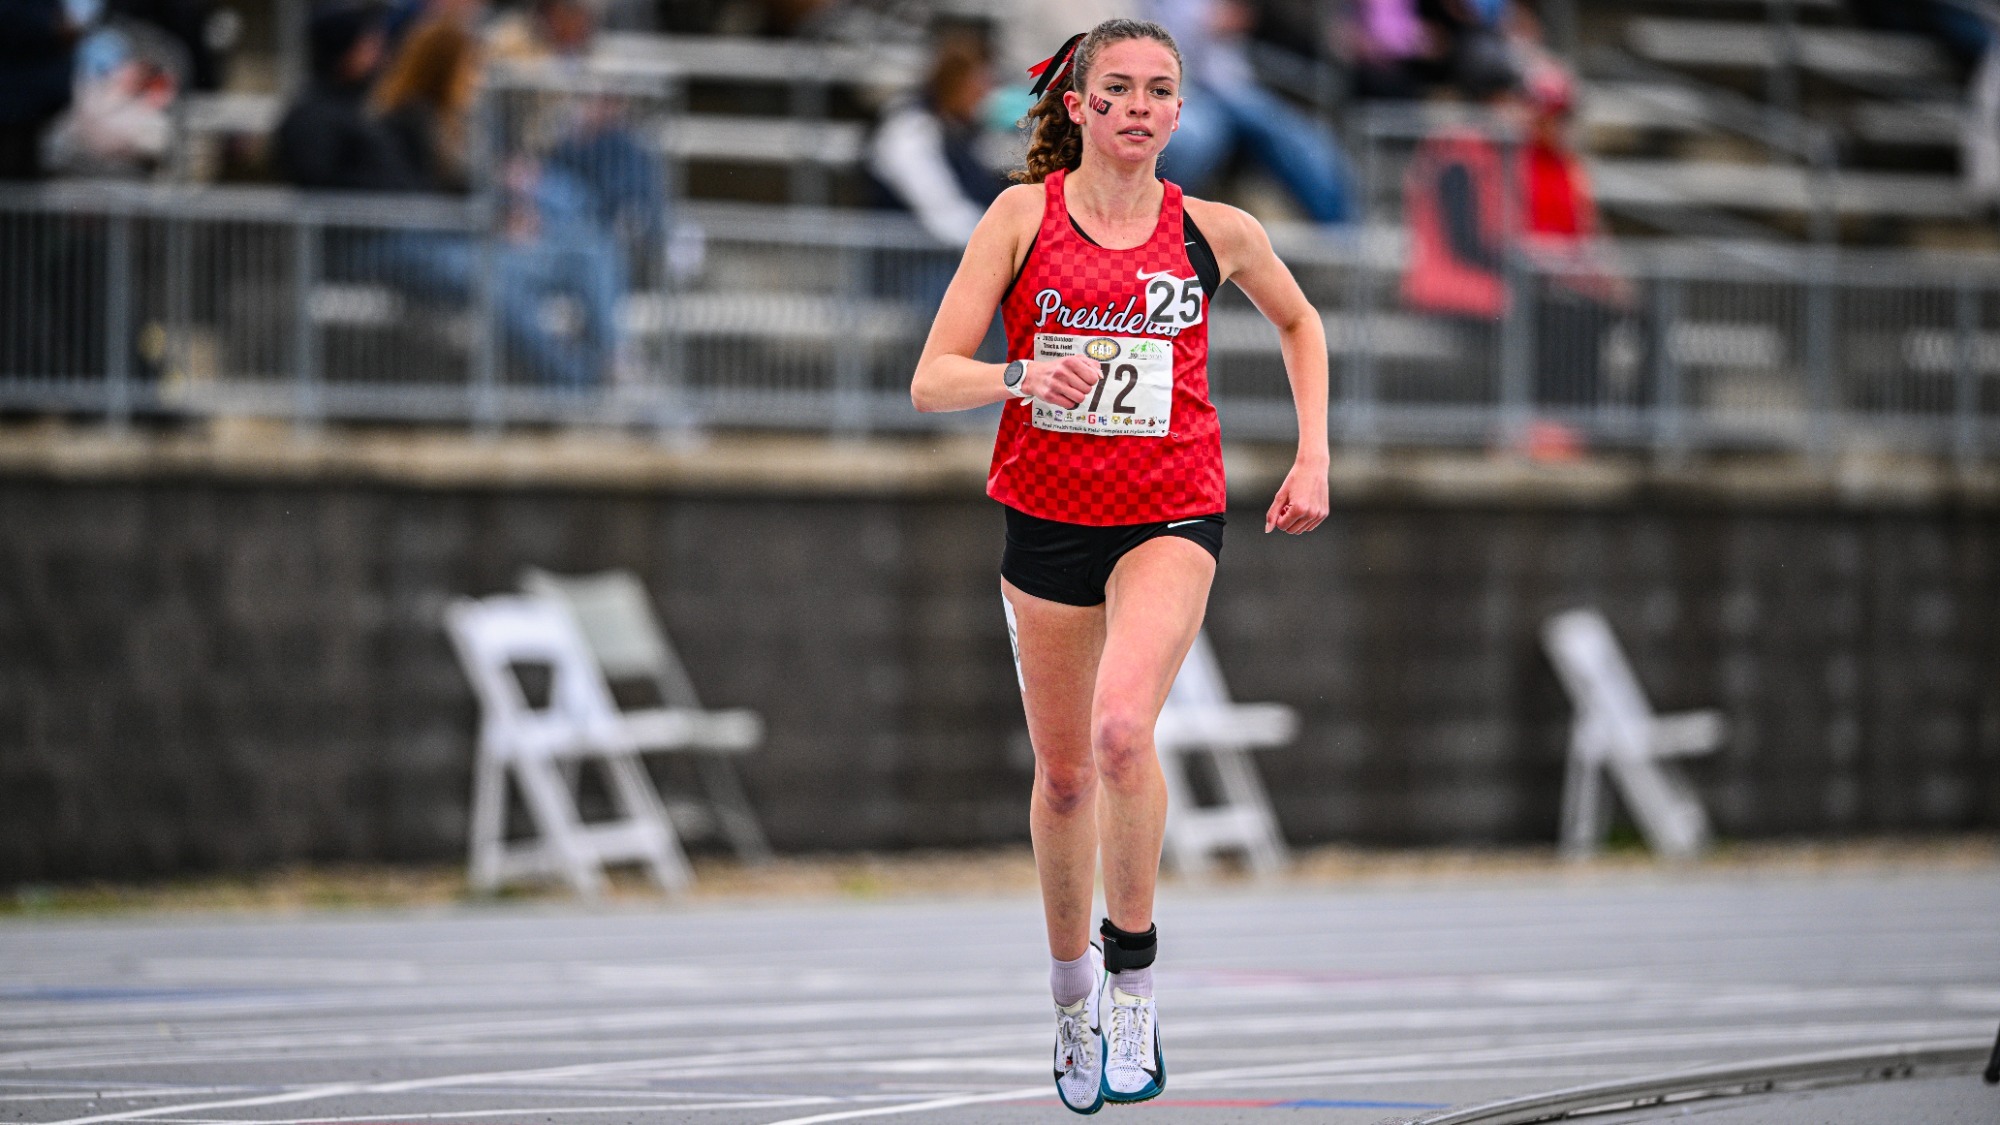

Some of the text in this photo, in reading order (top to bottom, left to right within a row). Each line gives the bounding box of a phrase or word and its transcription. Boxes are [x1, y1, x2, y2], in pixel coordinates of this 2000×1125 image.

[1148, 279, 1202, 323] 25
[1054, 335, 1073, 343] Outdoor
[1091, 344, 1113, 356] PAC
[1066, 363, 1138, 414] 72
[1088, 414, 1096, 424] G
